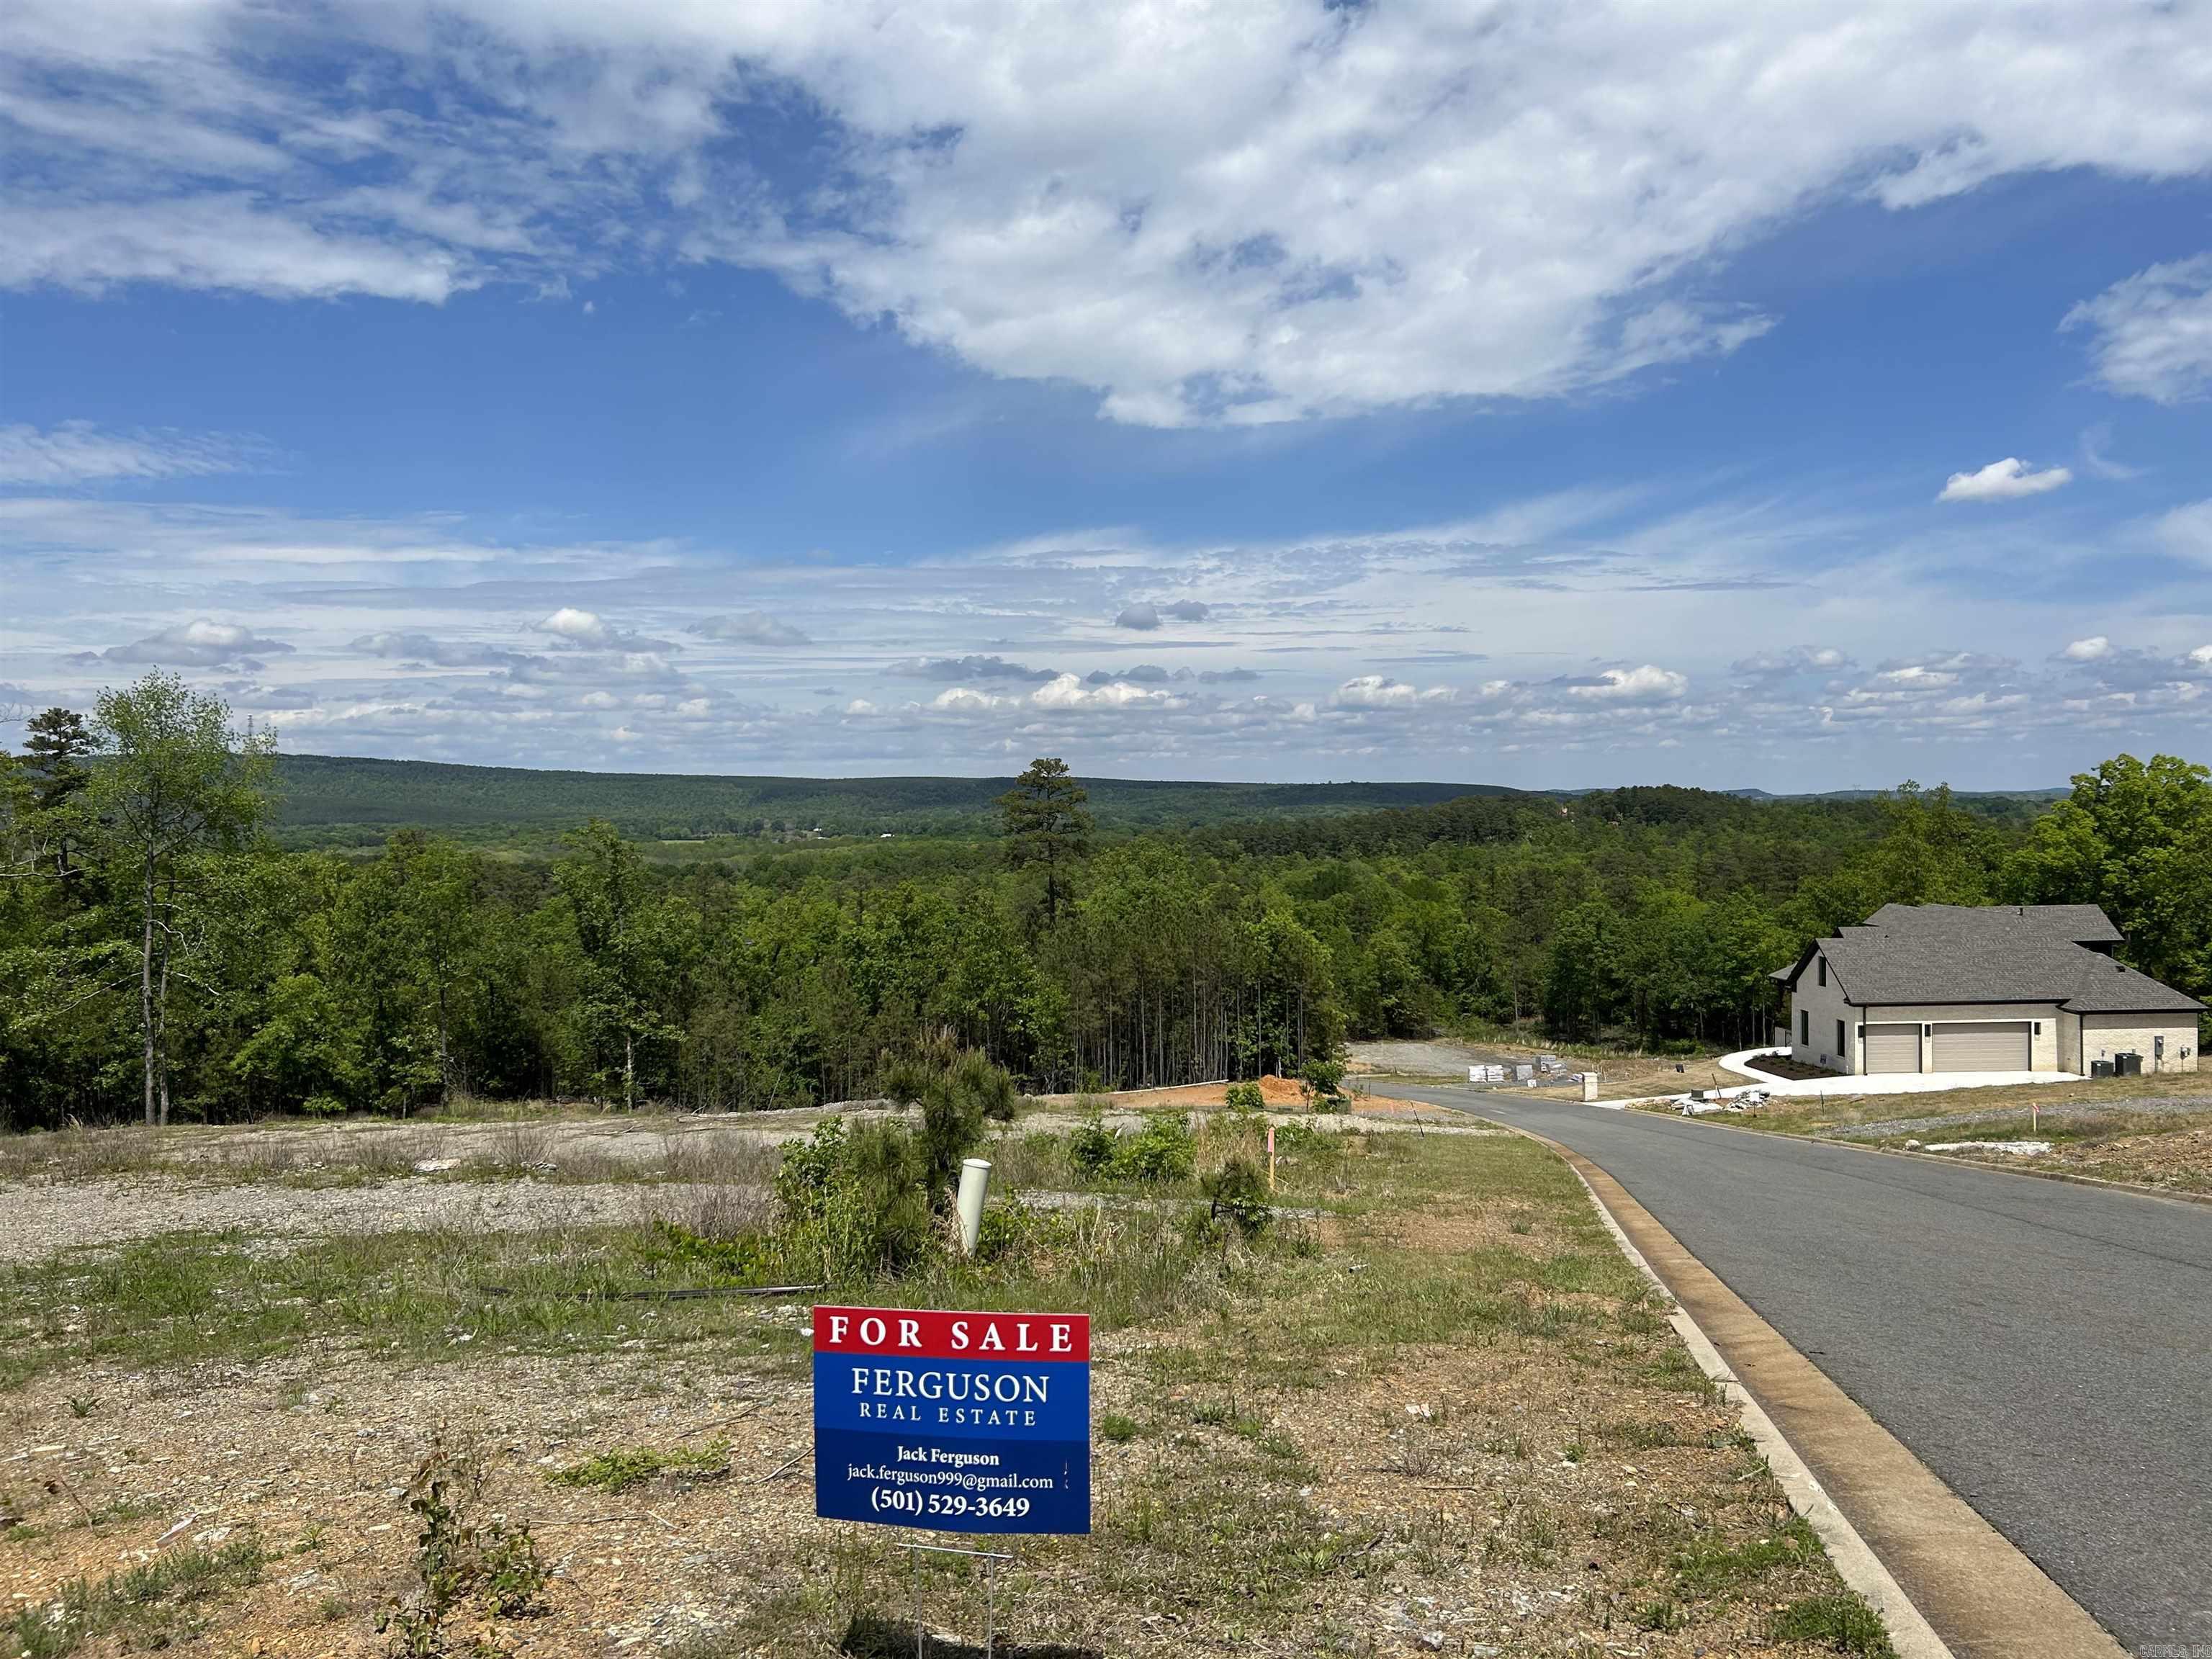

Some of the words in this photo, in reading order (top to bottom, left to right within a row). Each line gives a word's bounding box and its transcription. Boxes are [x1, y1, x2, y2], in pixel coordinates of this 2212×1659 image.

[829, 1316, 922, 1348] FOR
[950, 1321, 1073, 1353] SALE
[851, 1367, 1049, 1403] FERGUSON
[859, 1403, 921, 1421] REAL
[938, 1407, 1035, 1426] ESTATE
[897, 1446, 927, 1462] Jack
[930, 1449, 999, 1467] Ferguson
[847, 1464, 1053, 1491] jack.ferguson999@gmail.com
[871, 1487, 923, 1516] (501)
[927, 1494, 1030, 1517] 529-3649
